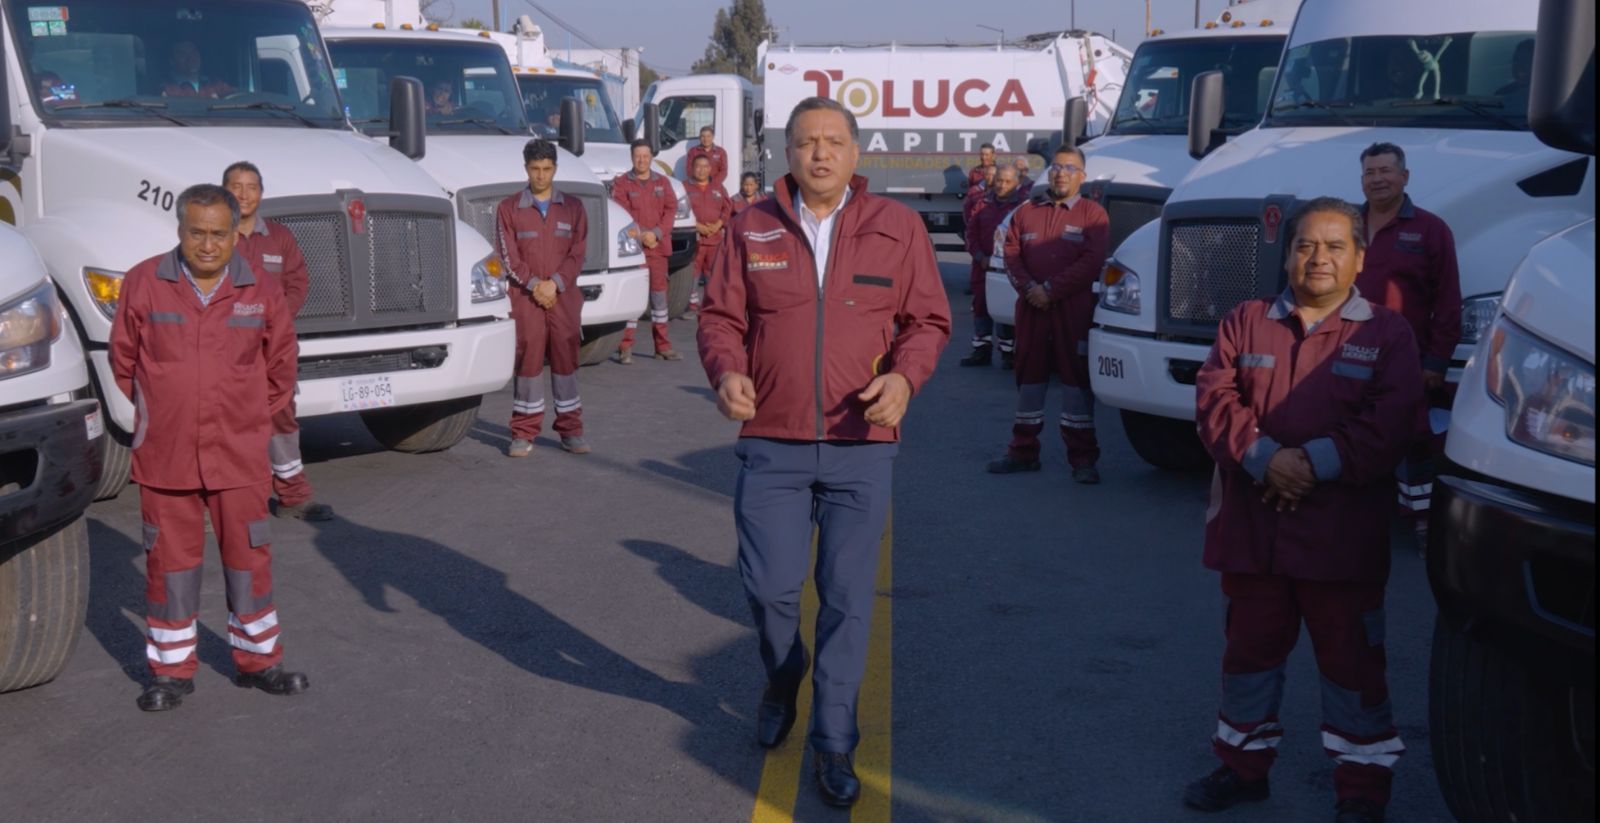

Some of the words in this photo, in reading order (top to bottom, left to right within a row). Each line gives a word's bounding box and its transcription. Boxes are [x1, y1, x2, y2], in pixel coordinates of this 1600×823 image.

[803, 69, 1035, 118] TOLUCA
[867, 132, 1034, 152] APITA
[1098, 355, 1124, 379] 2051
